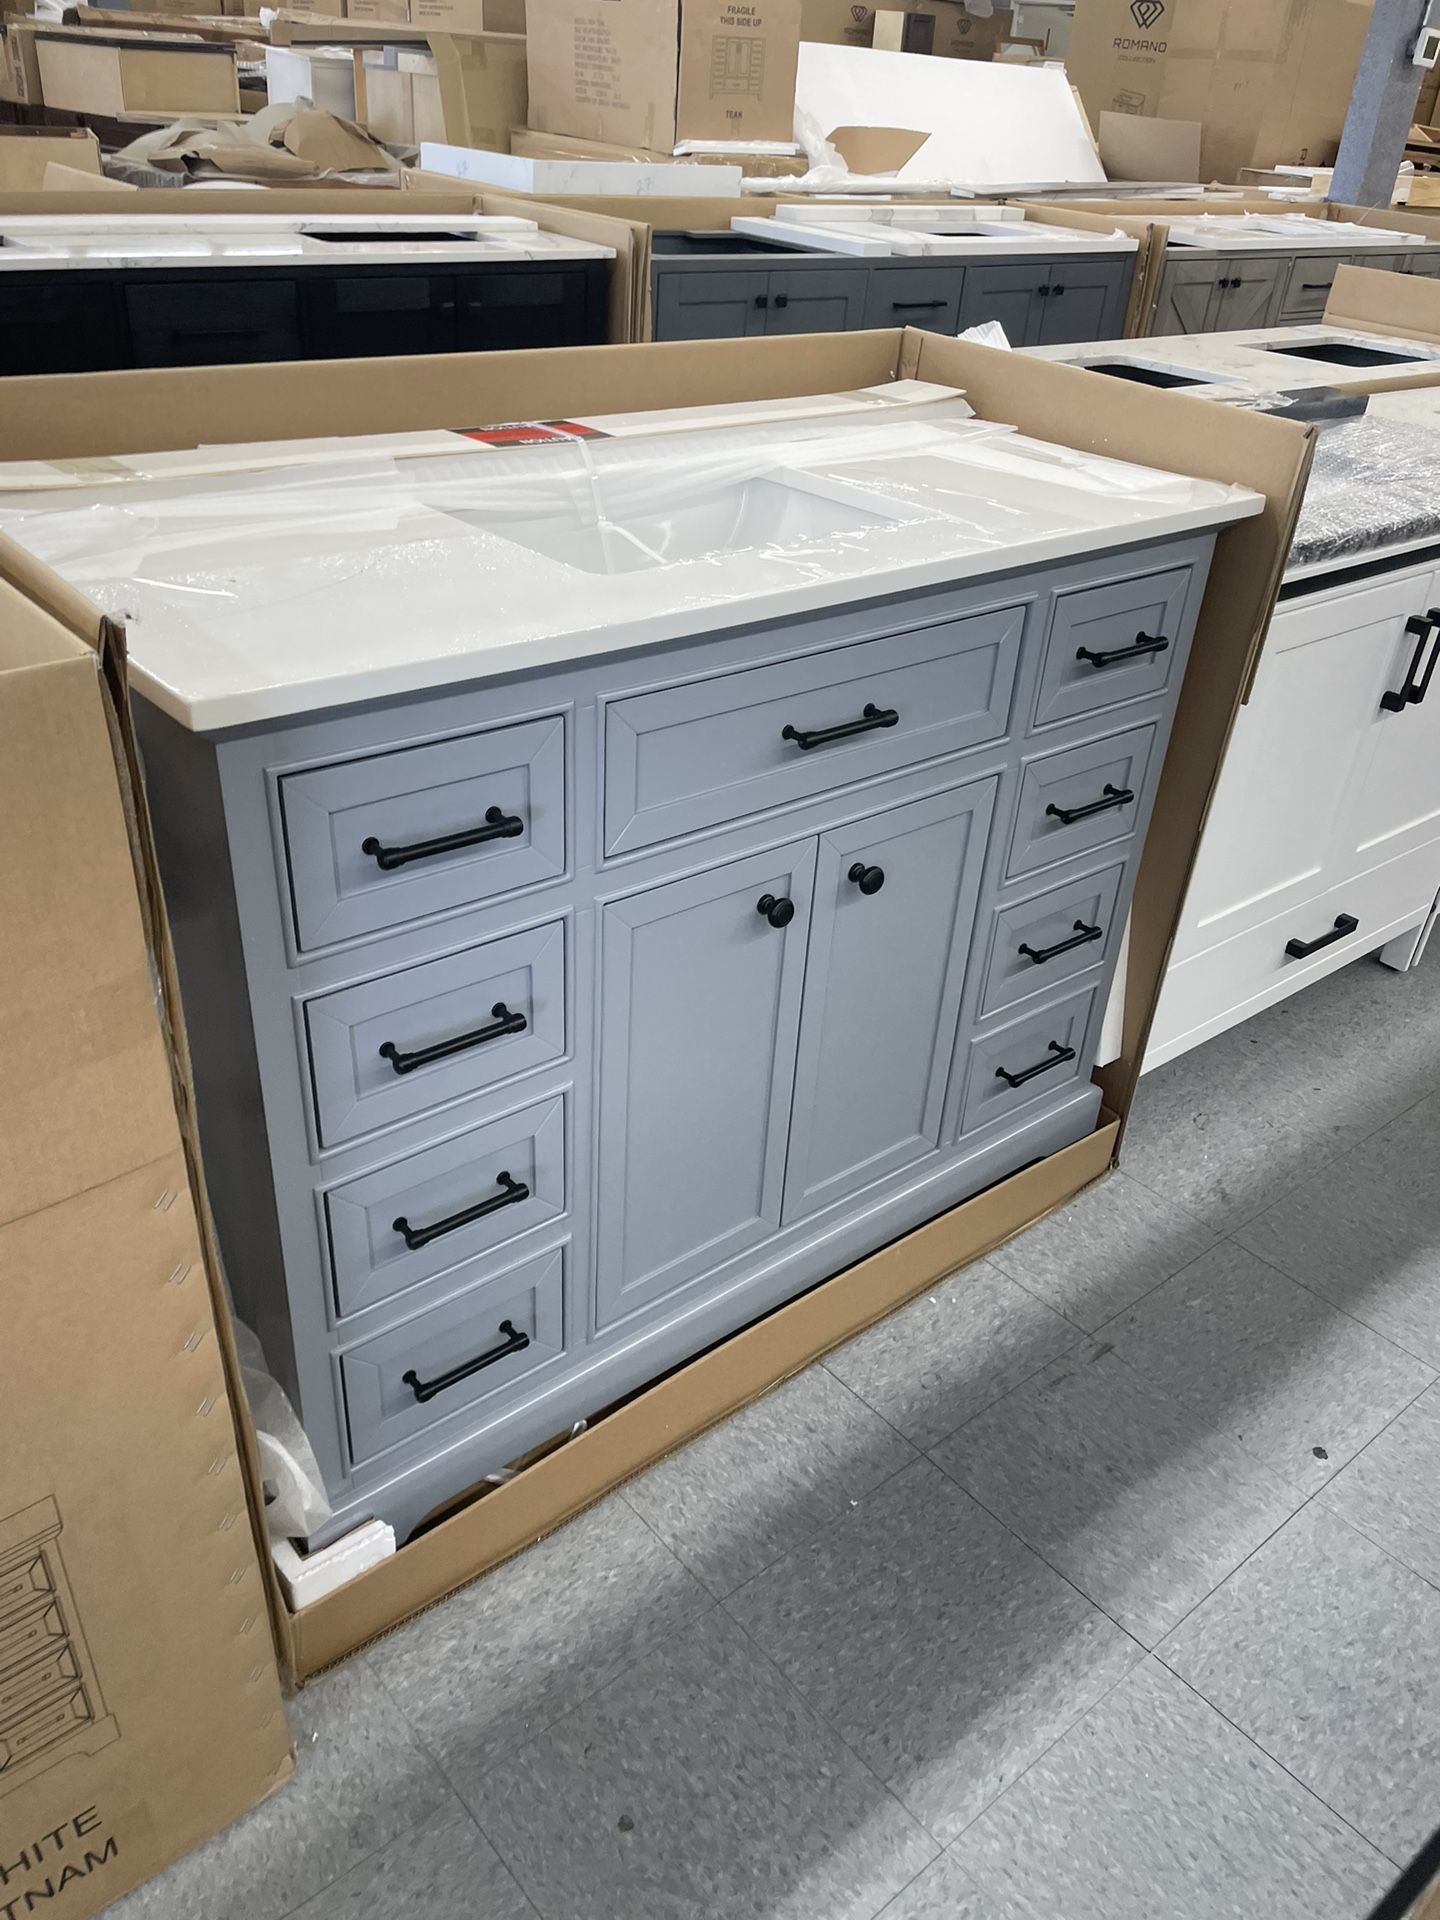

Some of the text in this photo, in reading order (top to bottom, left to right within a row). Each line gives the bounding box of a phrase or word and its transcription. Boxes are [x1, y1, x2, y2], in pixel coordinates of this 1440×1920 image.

[727, 5, 756, 16] FRAGILE
[720, 16, 762, 27] THIS SIDE UP
[1112, 38, 1168, 53] ROMANO
